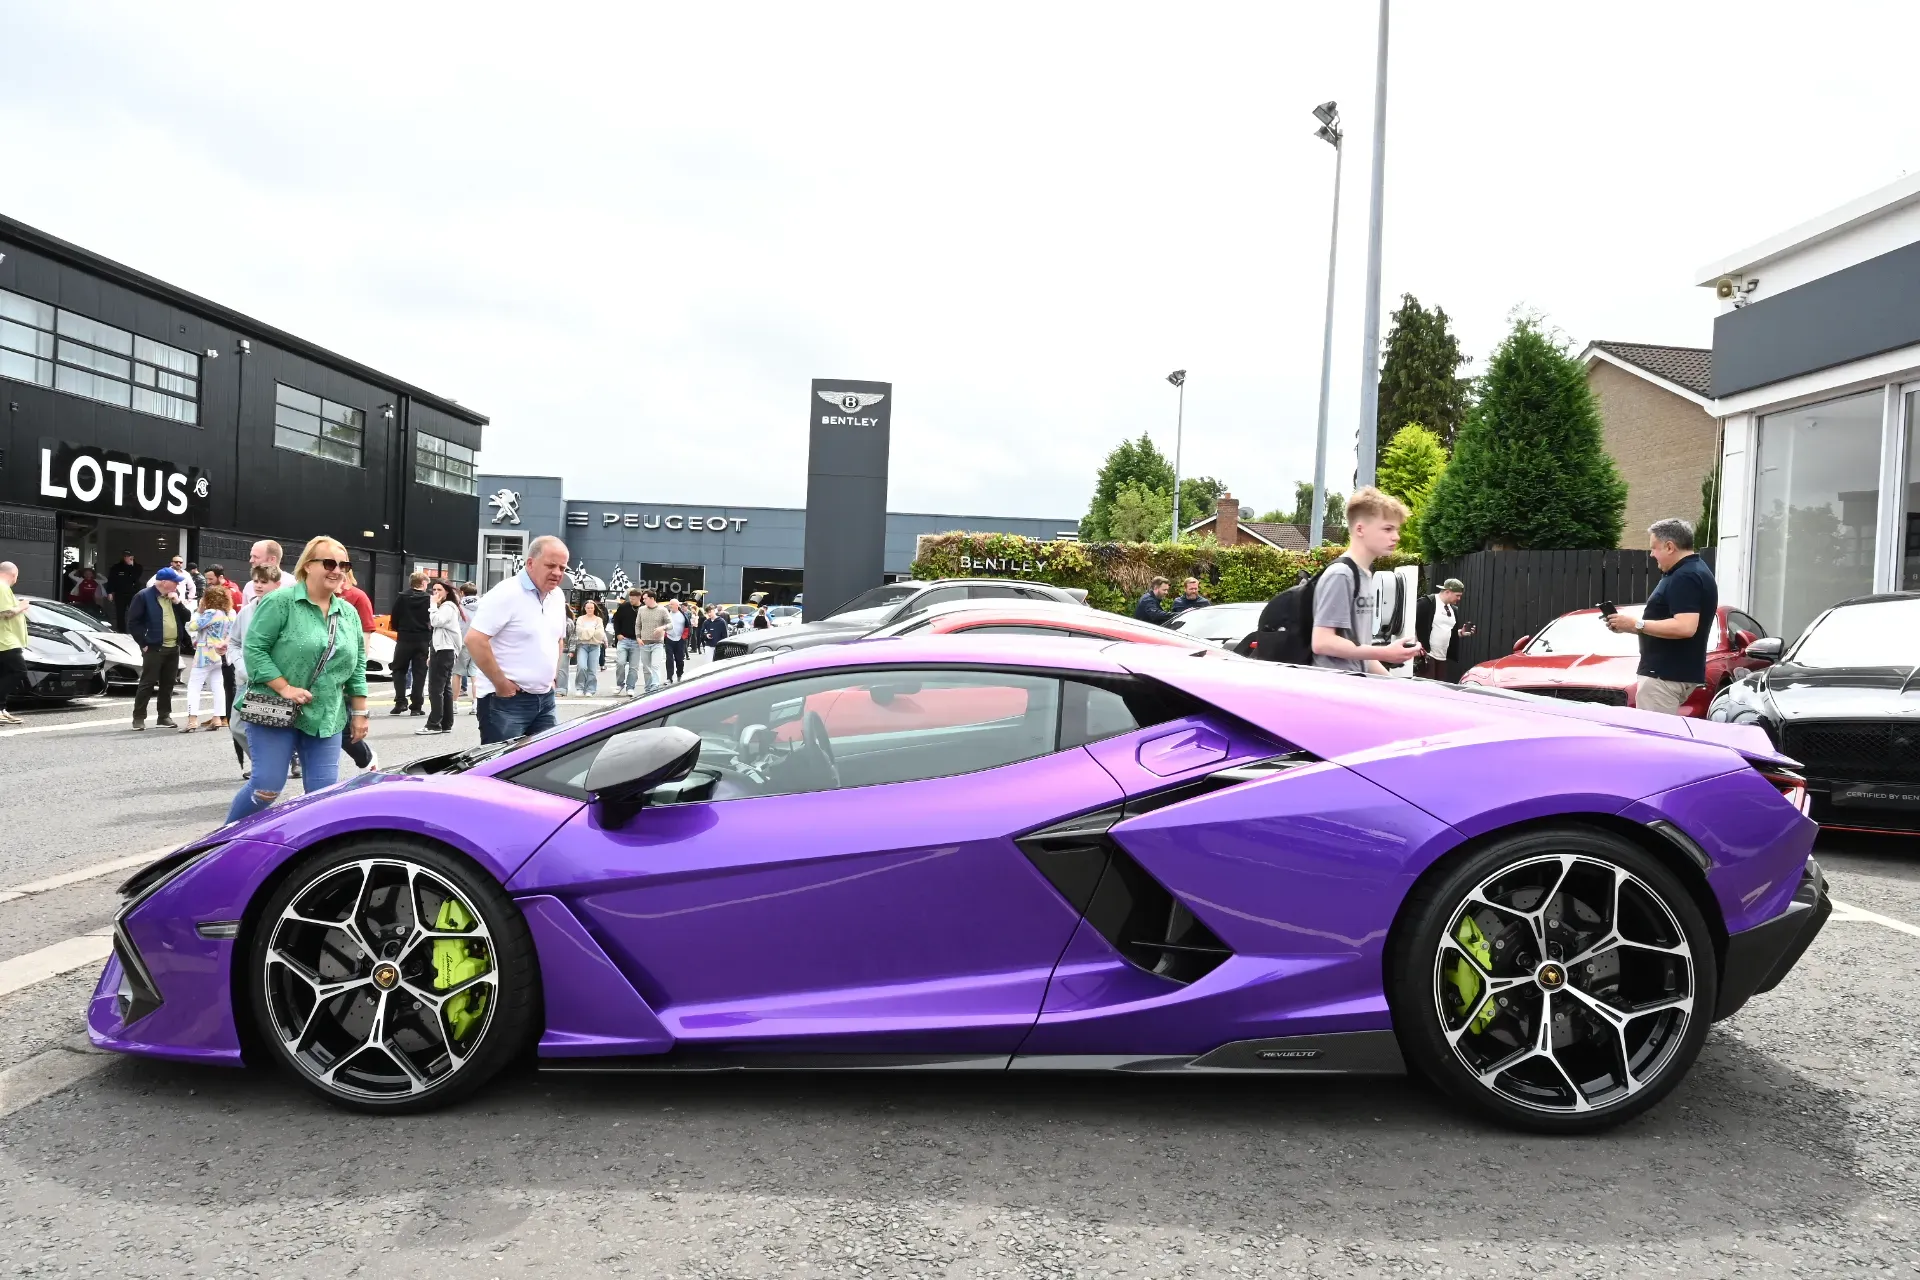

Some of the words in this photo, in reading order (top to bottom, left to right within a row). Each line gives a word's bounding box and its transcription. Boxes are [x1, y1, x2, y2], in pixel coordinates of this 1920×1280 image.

[821, 415, 879, 427] BENTLEY
[40, 447, 188, 515] LOTUS
[602, 512, 748, 533] PEUGEOT
[960, 555, 1047, 573] BENTLEY
[1846, 791, 1887, 799] CERTIFIED
[1263, 1050, 1317, 1058] REVUELTO
